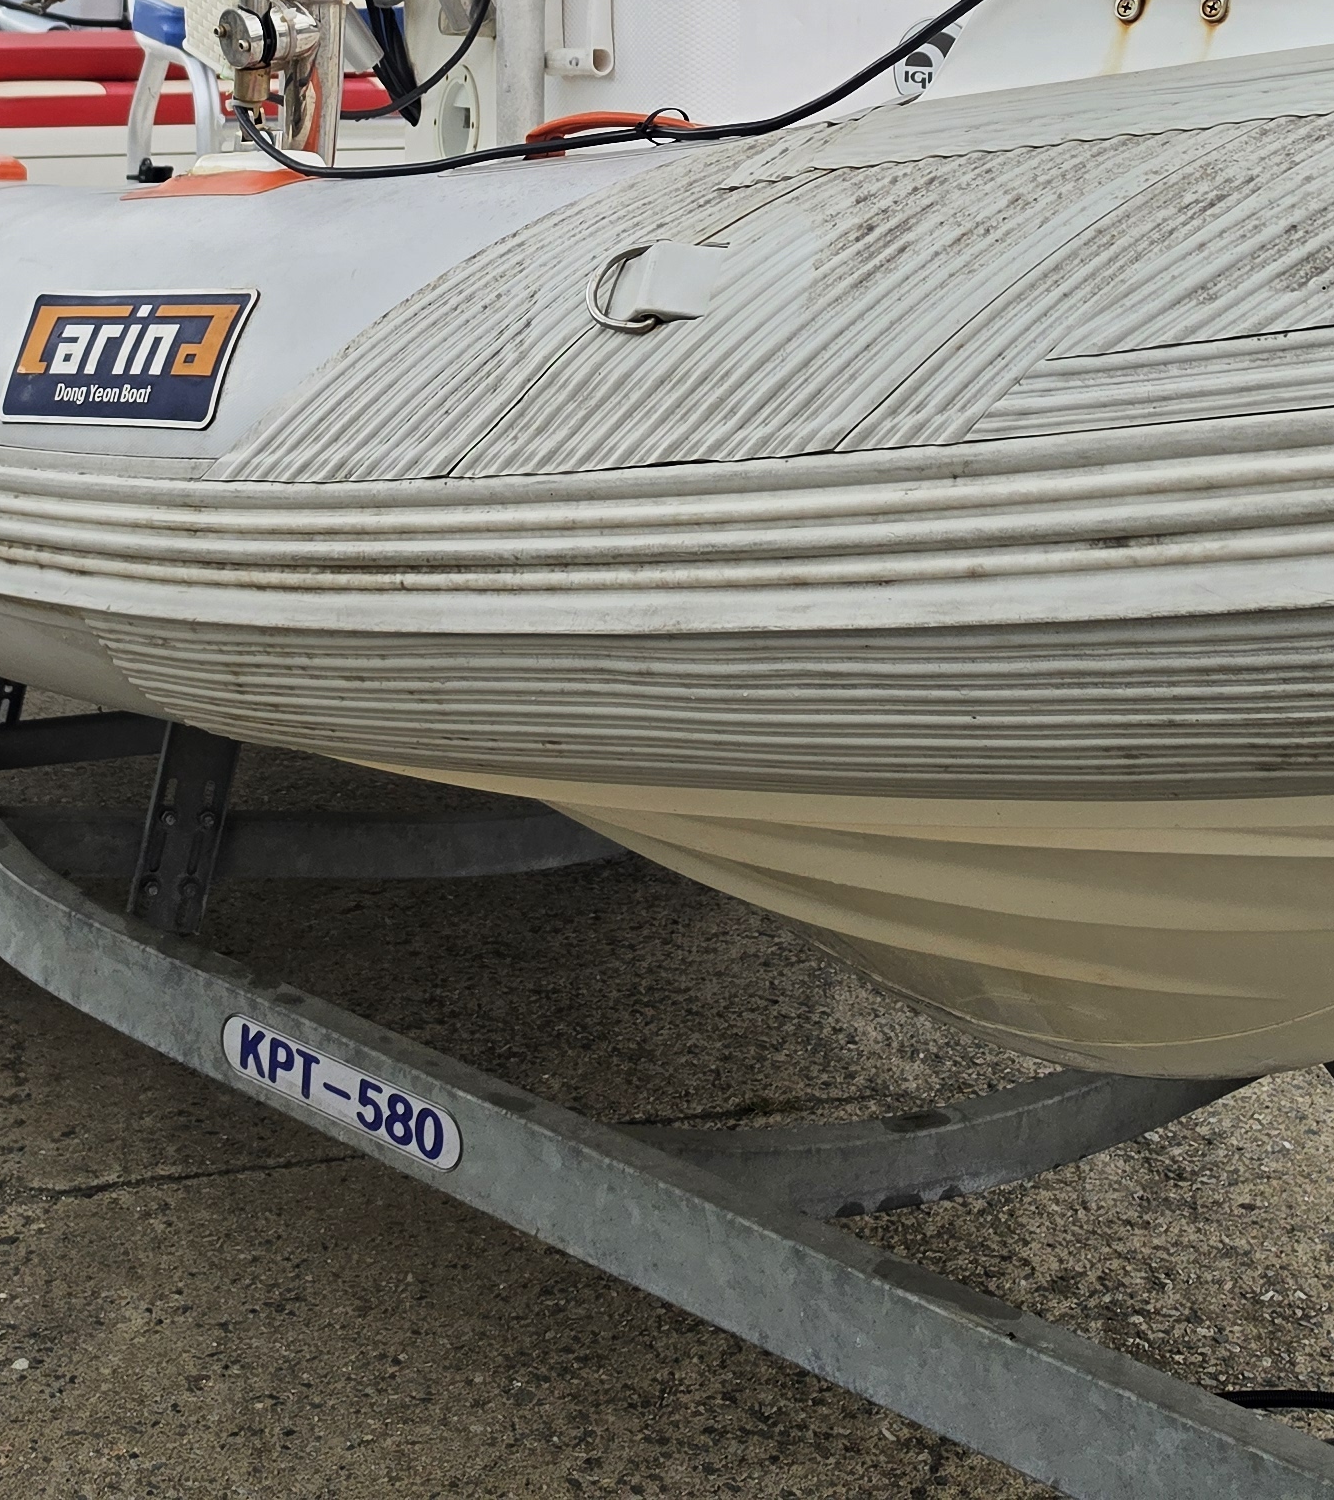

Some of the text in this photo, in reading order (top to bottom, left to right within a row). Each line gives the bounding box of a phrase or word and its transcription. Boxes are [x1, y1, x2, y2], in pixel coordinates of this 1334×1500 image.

[54, 382, 152, 405] Dong Yeon Boat
[238, 1023, 445, 1160] KPT-580
